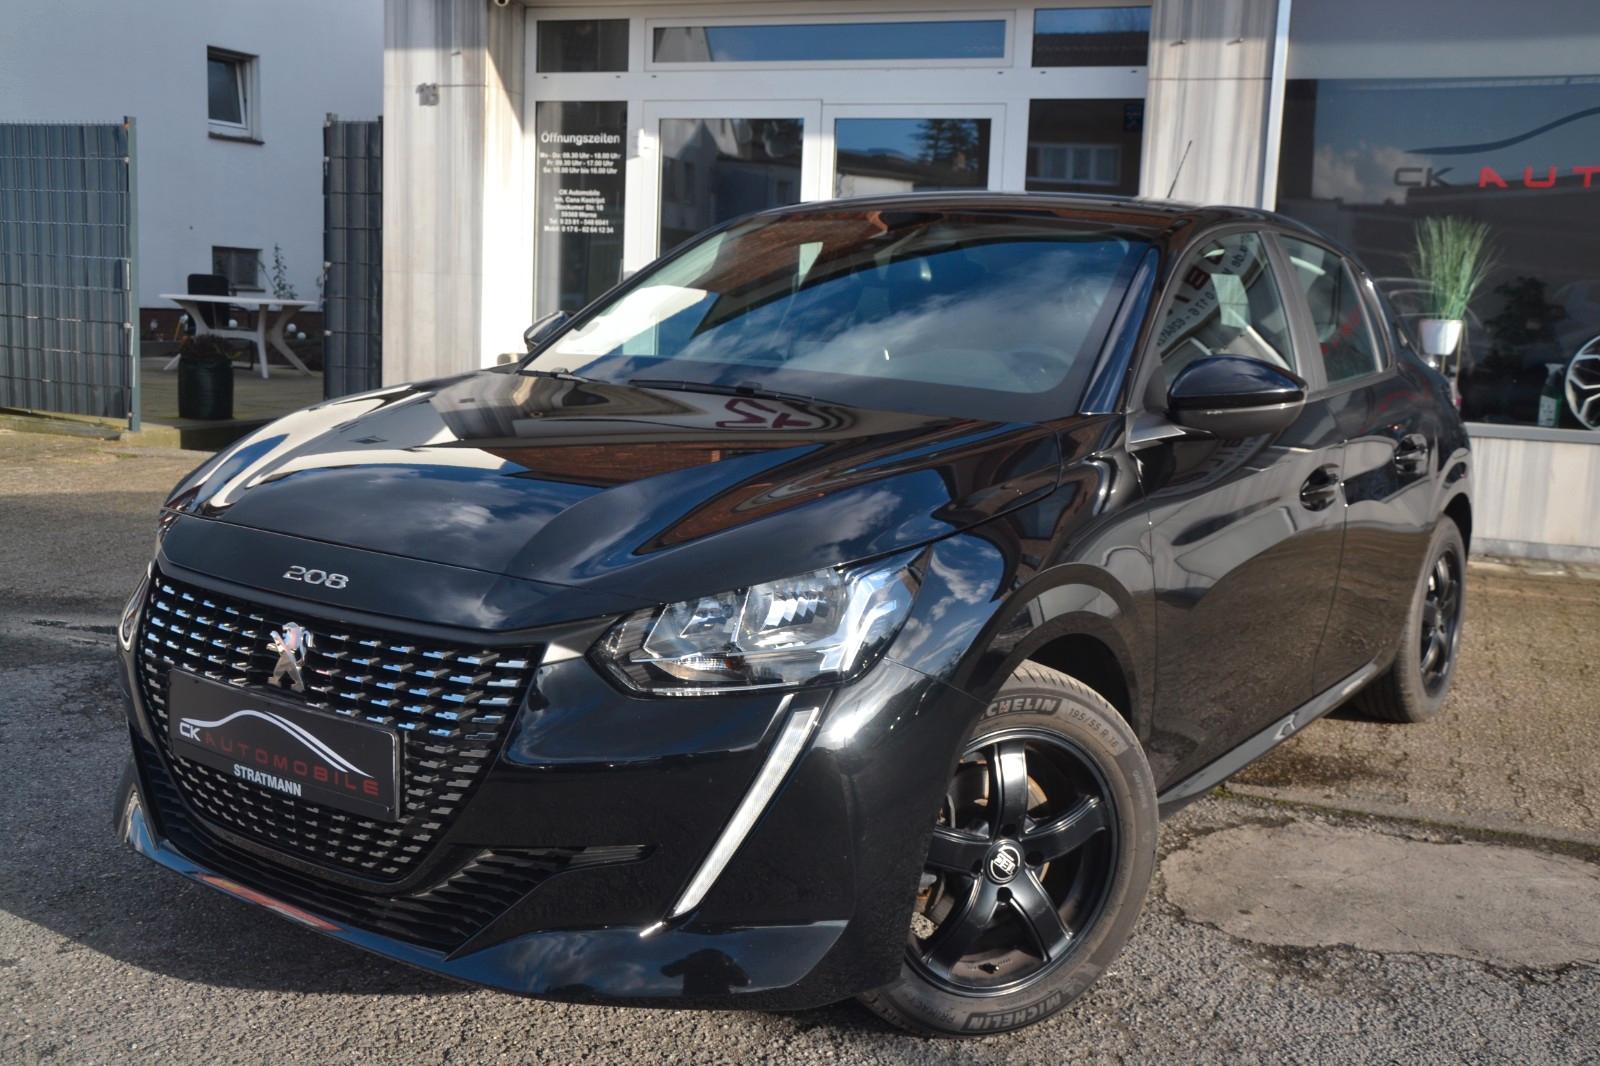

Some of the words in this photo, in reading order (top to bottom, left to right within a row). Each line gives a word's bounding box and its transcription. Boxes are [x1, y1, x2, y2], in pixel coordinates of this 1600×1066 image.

[540, 132, 620, 146] Öffnungszeiten
[1393, 166, 1455, 187] CK
[282, 565, 350, 590] 208
[179, 720, 202, 743] CK
[203, 731, 380, 796] AUTOMOBILE
[233, 763, 303, 798] STRATMANN
[967, 992, 1062, 1030] MICHELIN
